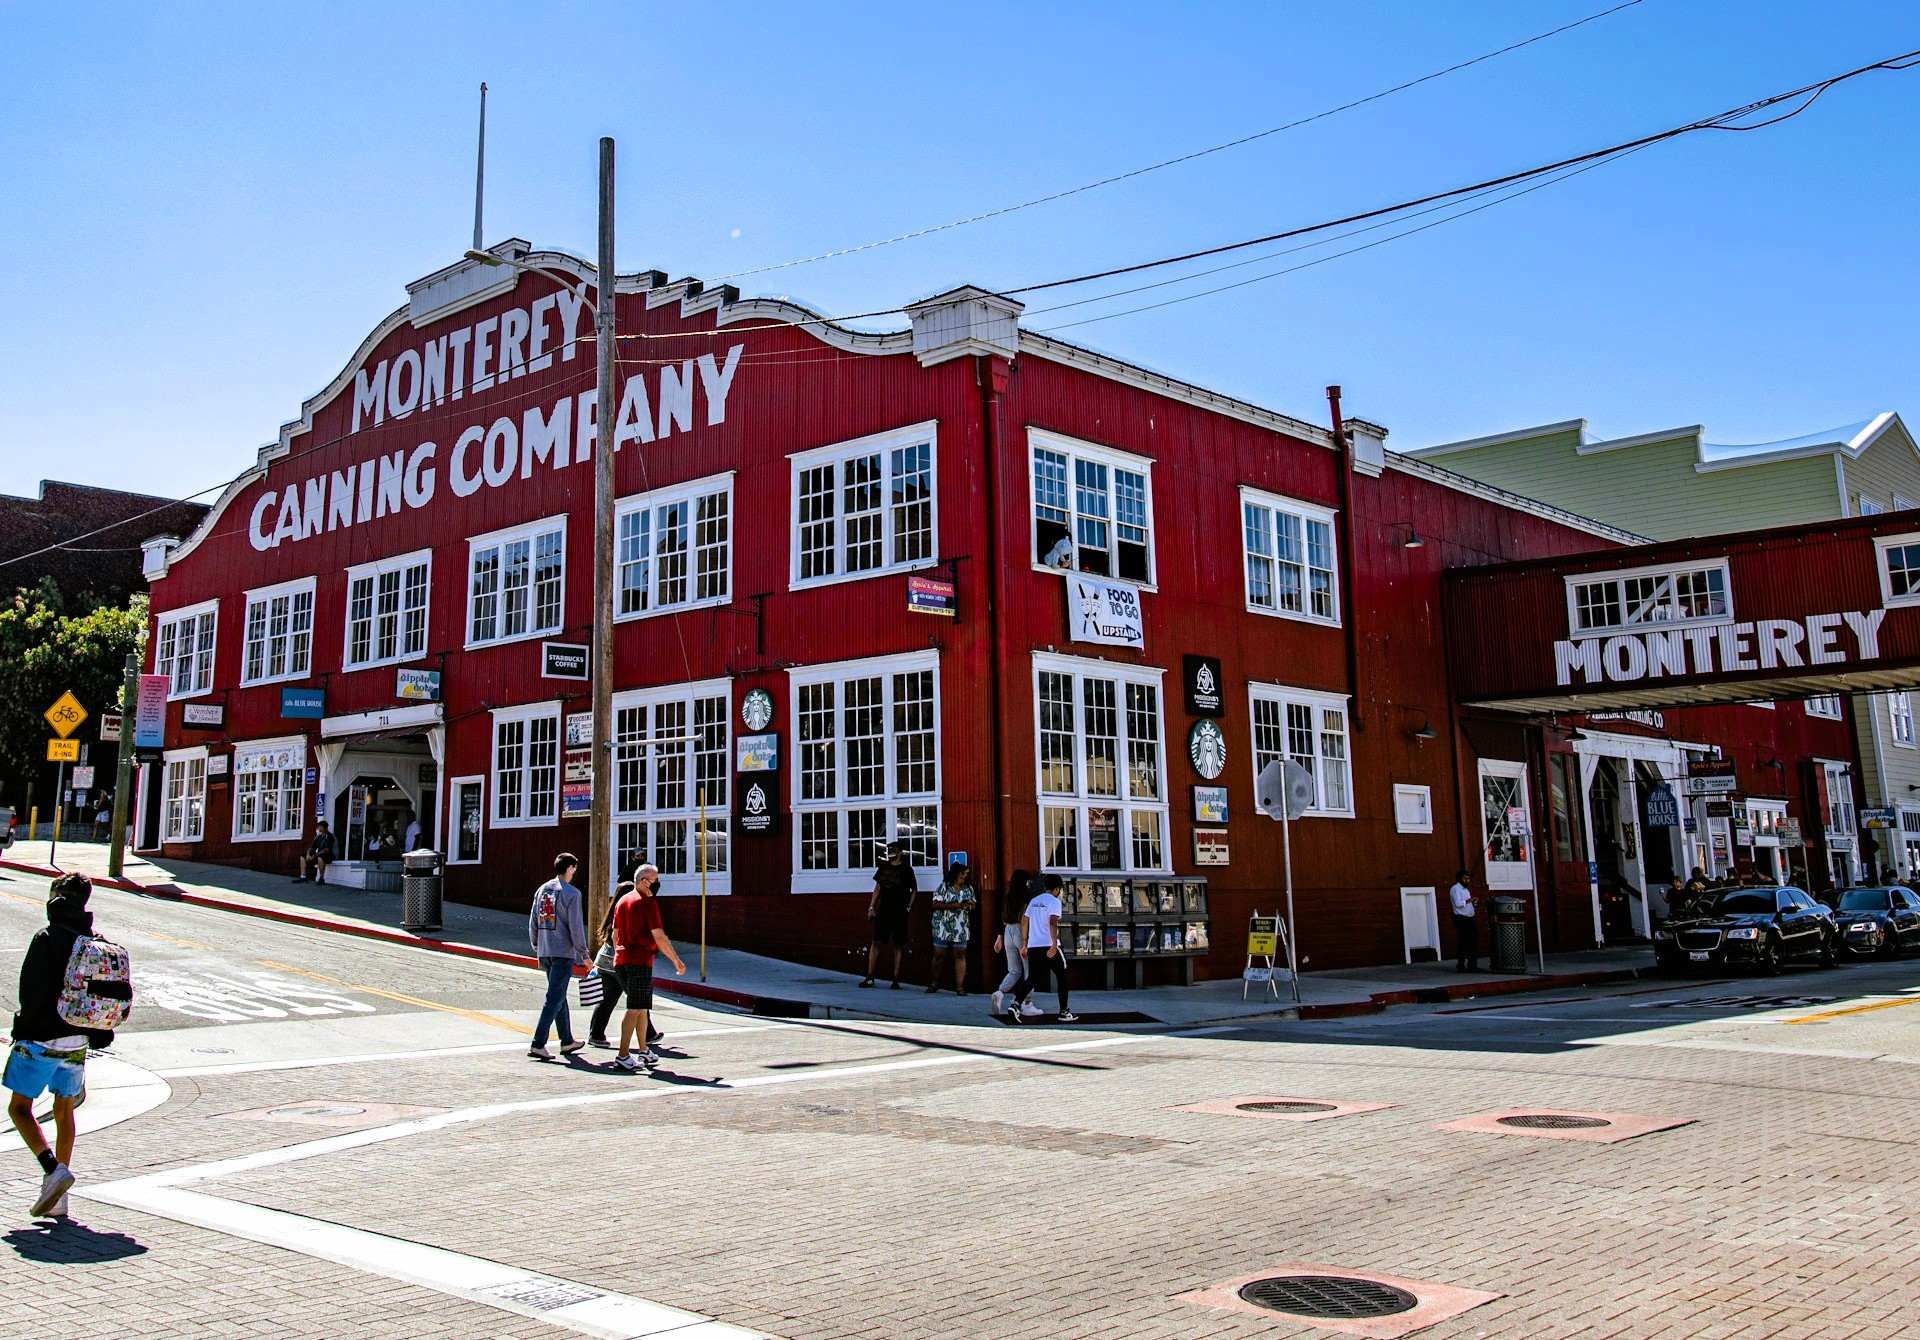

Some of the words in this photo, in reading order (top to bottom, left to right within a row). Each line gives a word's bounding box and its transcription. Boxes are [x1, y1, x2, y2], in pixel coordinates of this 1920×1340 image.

[351, 282, 587, 434] MONTEREY
[249, 441, 437, 552] CANNING
[1106, 588, 1134, 604] FOOD
[1109, 602, 1123, 616] TO
[1124, 605, 1138, 619] GO
[1103, 626, 1140, 638] UPSTAIRS
[1554, 609, 1886, 686] MONTEREY
[379, 716, 389, 726] 711
[1648, 801, 1676, 814] BLUE
[1649, 814, 1676, 825] HOUSE
